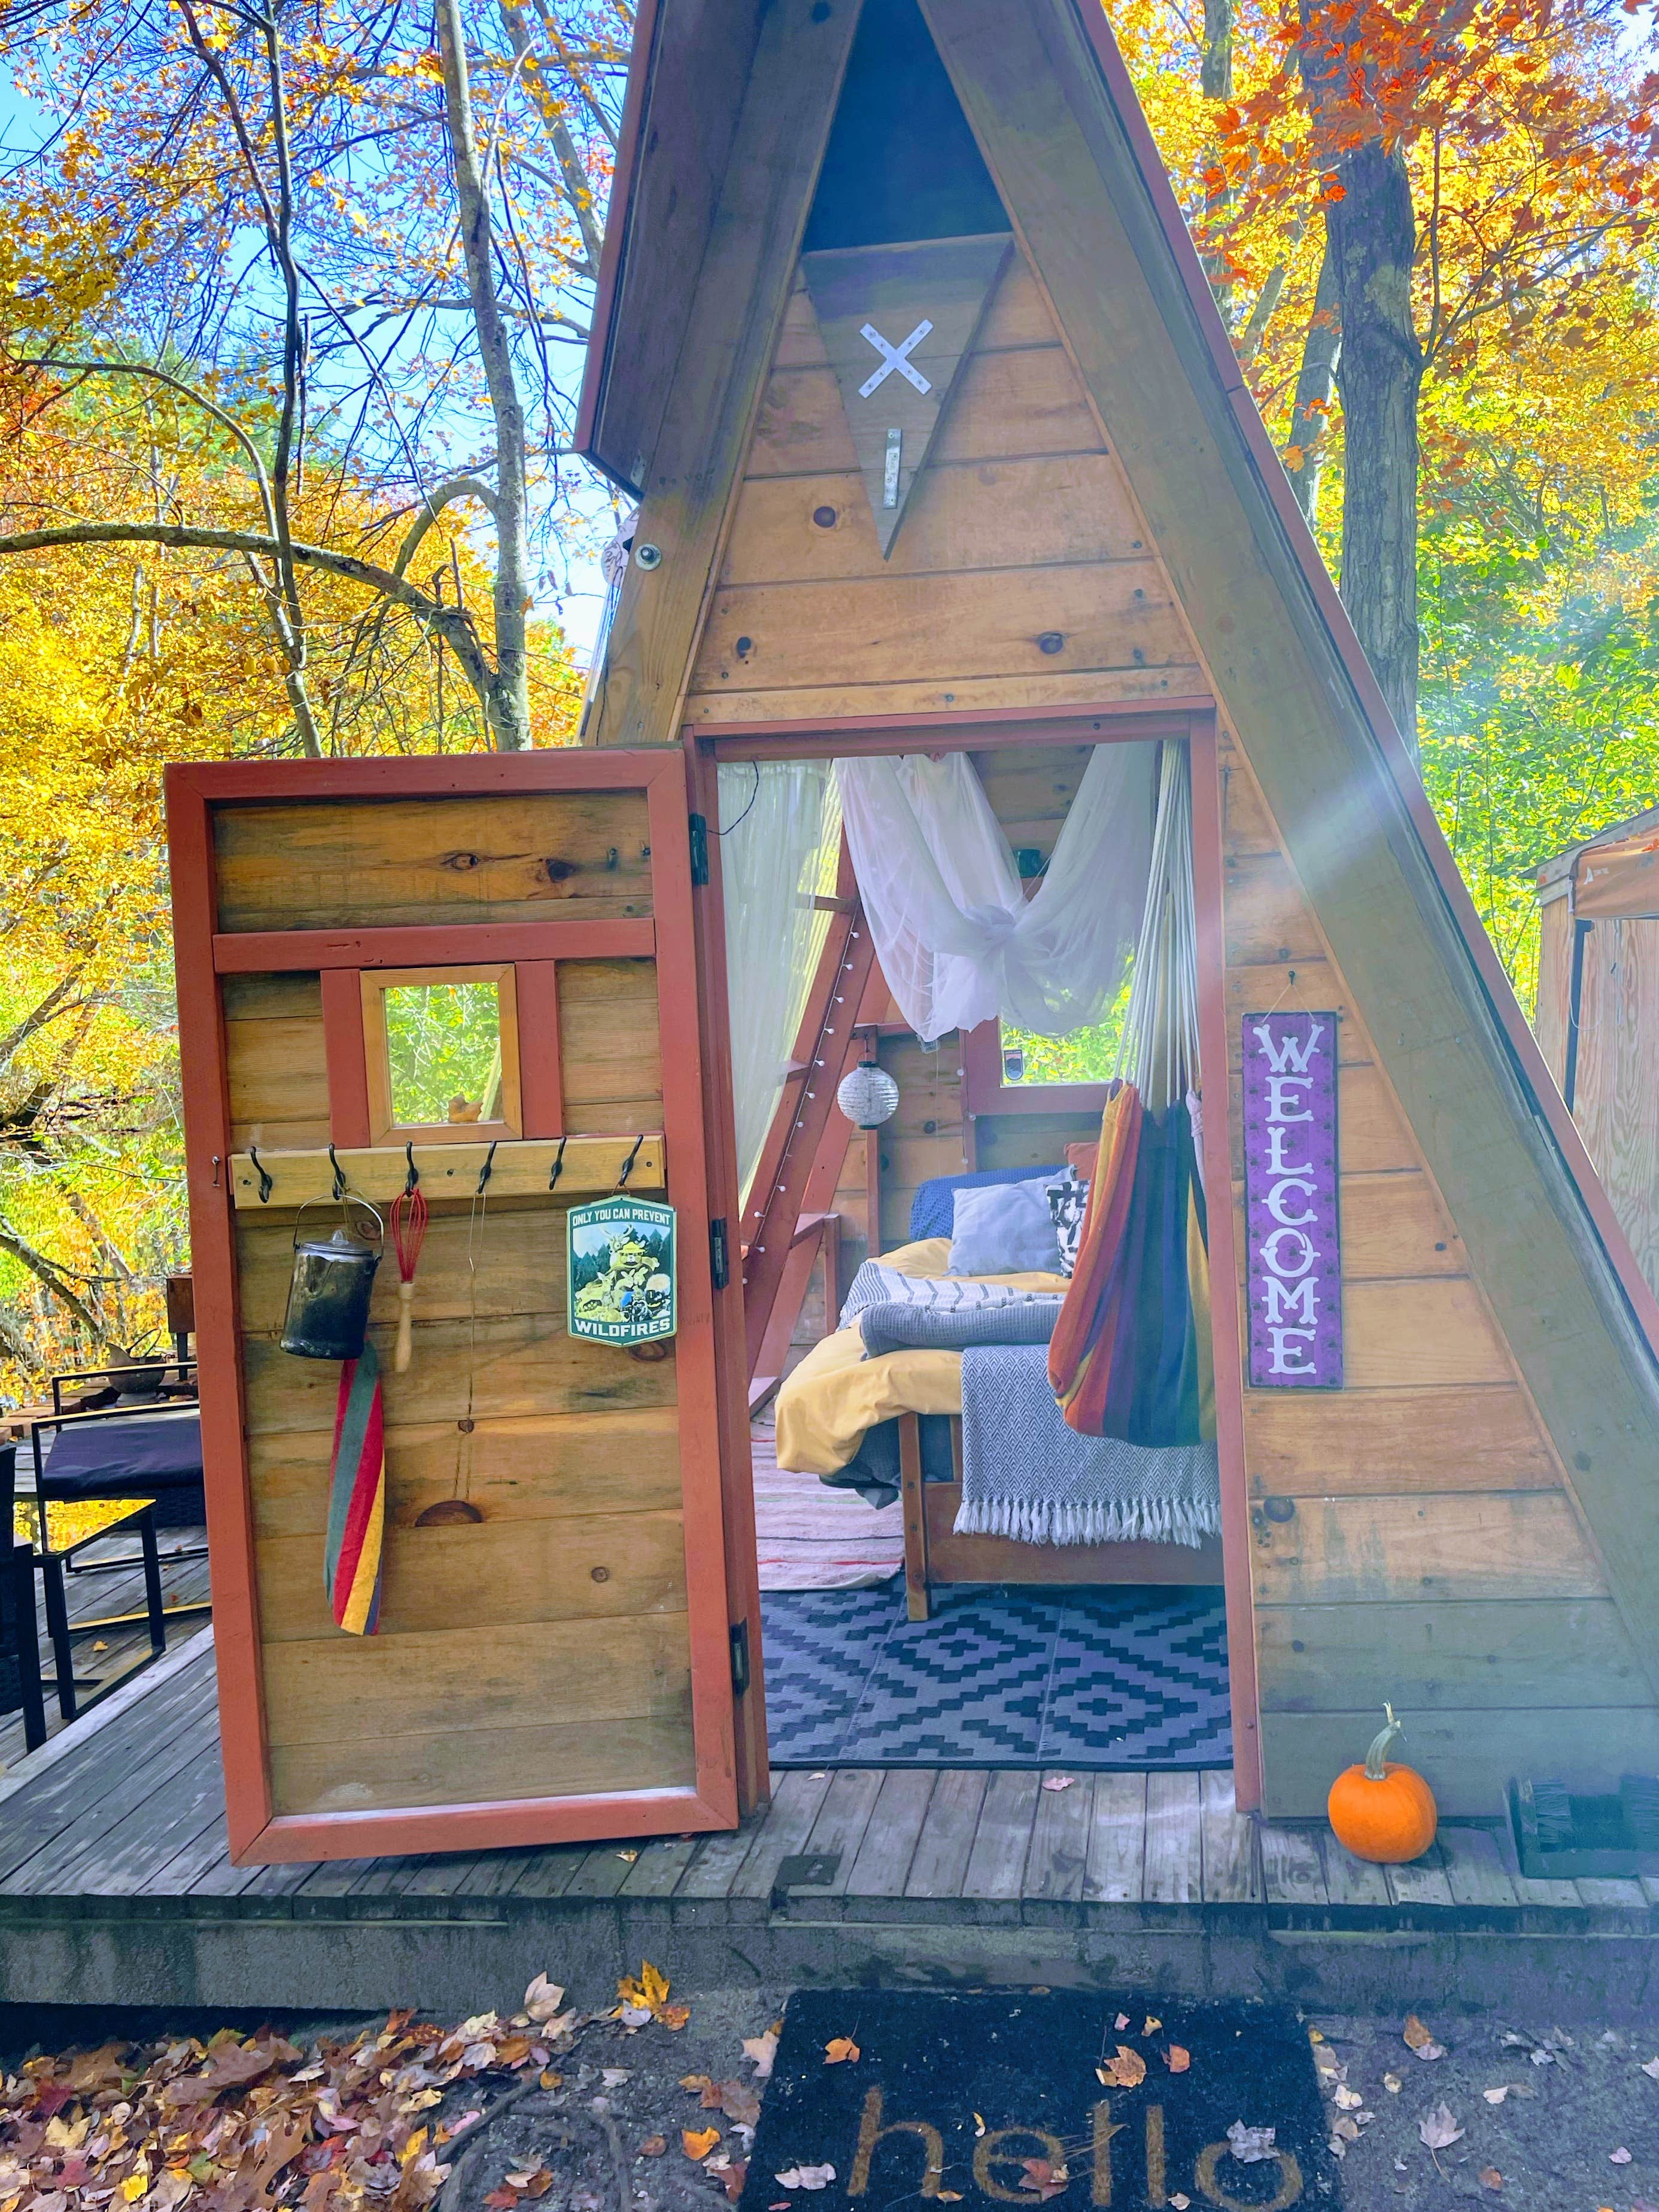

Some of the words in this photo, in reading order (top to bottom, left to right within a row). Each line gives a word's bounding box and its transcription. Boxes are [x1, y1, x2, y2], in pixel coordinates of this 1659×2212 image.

[573, 1210, 592, 1226] ONLY
[594, 1209, 611, 1221] YOU
[613, 1209, 630, 1219] CAN
[632, 1209, 670, 1225] PREVENT
[1253, 1024, 1324, 1374] WELCOME
[575, 1318, 670, 1337] WILDFIRES
[846, 2085, 1304, 2212] hello
